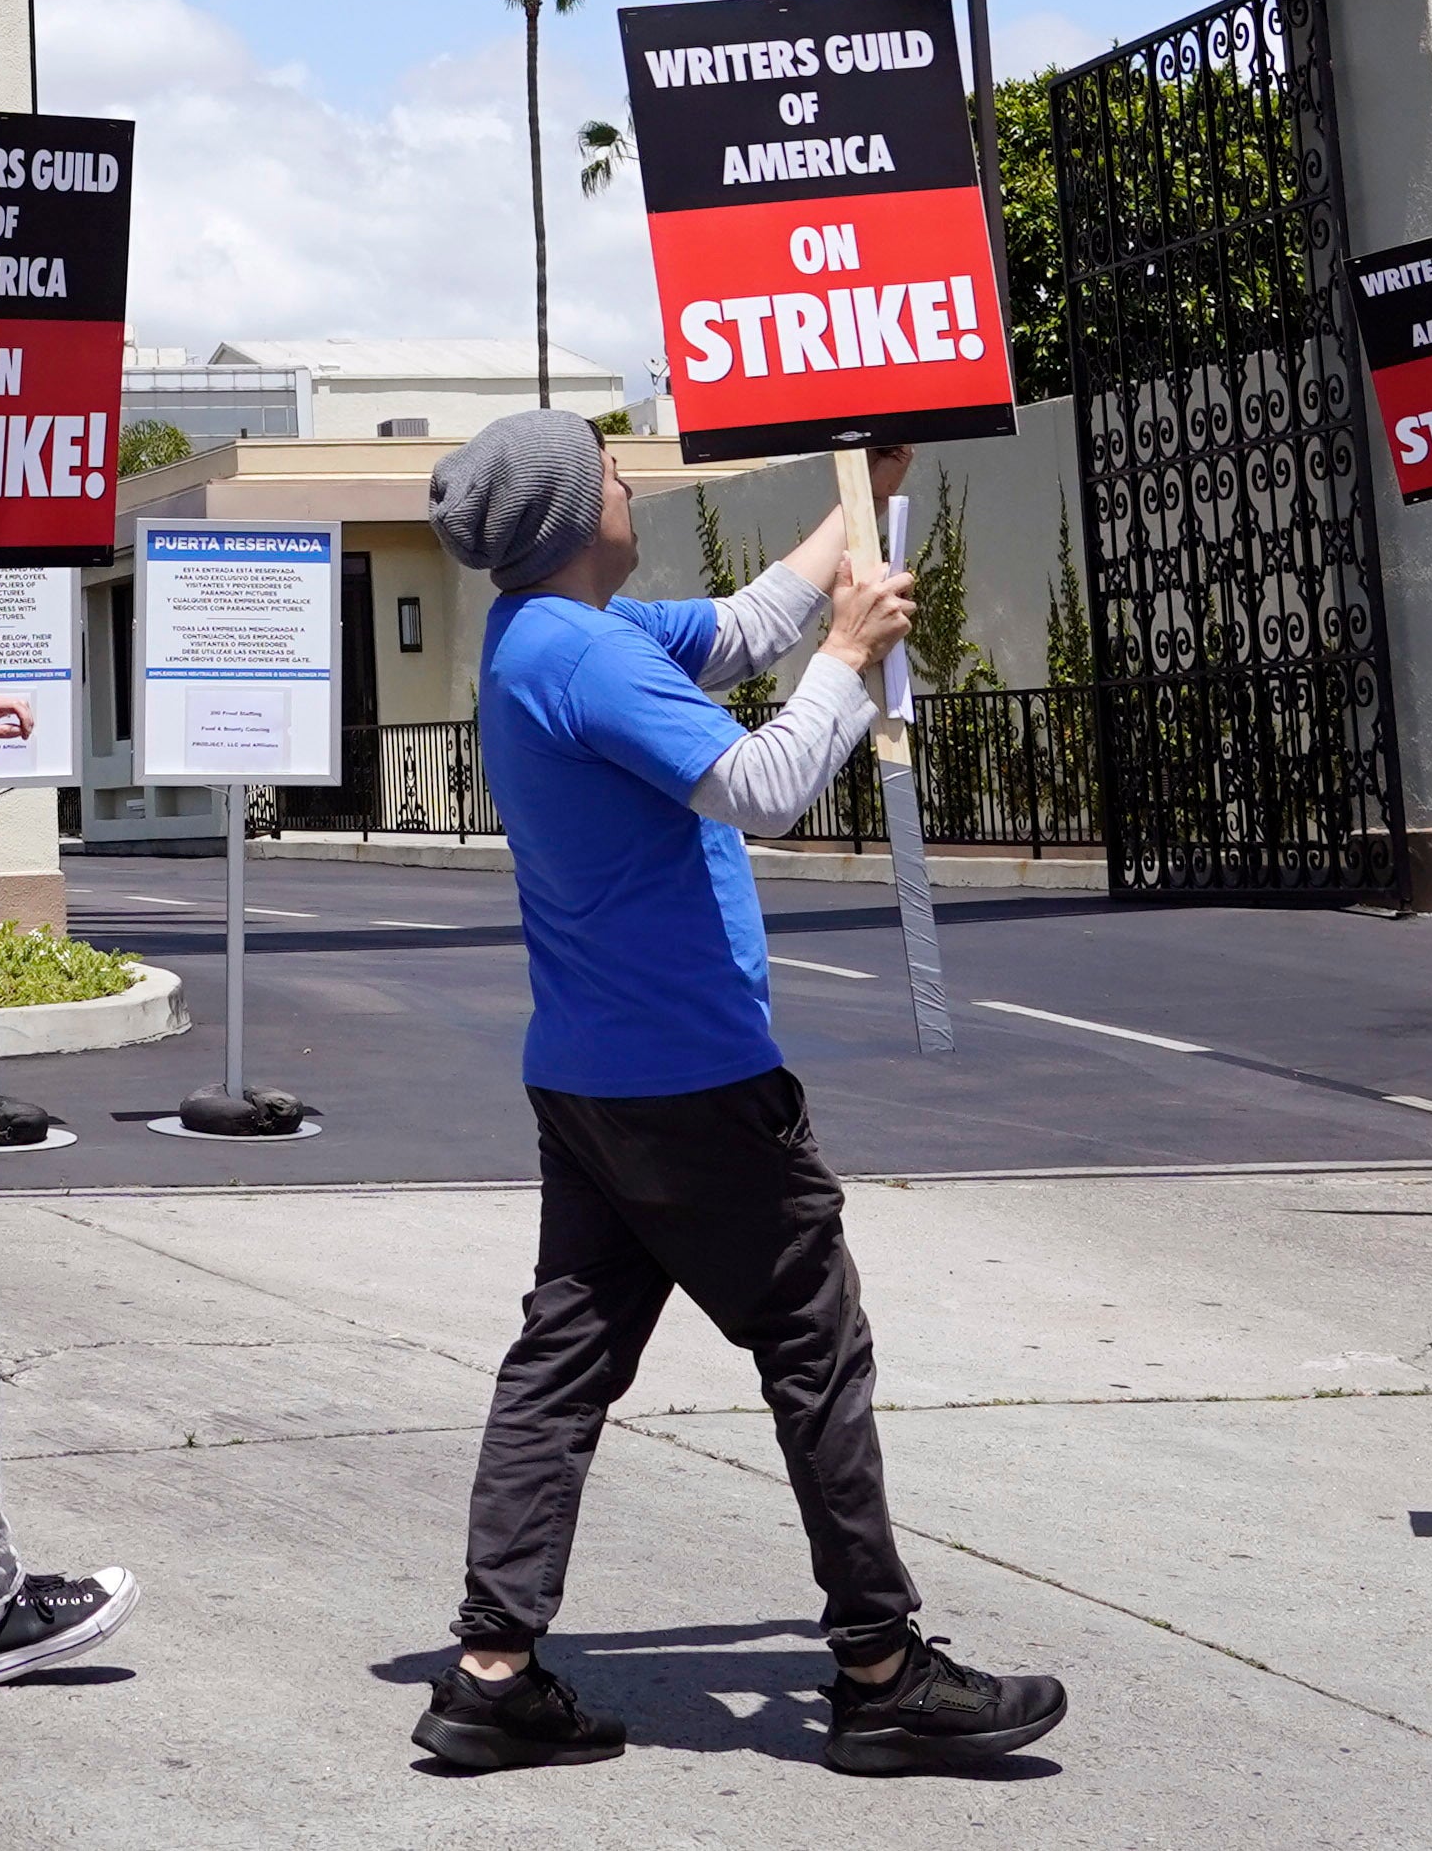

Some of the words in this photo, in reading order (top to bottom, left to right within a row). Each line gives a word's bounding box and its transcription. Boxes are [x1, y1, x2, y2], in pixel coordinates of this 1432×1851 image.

[645, 38, 819, 88] WRITERS
[825, 30, 933, 74] GUILD
[779, 92, 818, 125] OF
[32, 150, 118, 192] GUILD
[723, 134, 895, 185] AMERICA
[790, 224, 860, 274] ON
[680, 275, 984, 382] STRIKE!
[154, 537, 221, 550] PUERTA
[224, 537, 323, 552] RESERVADA
